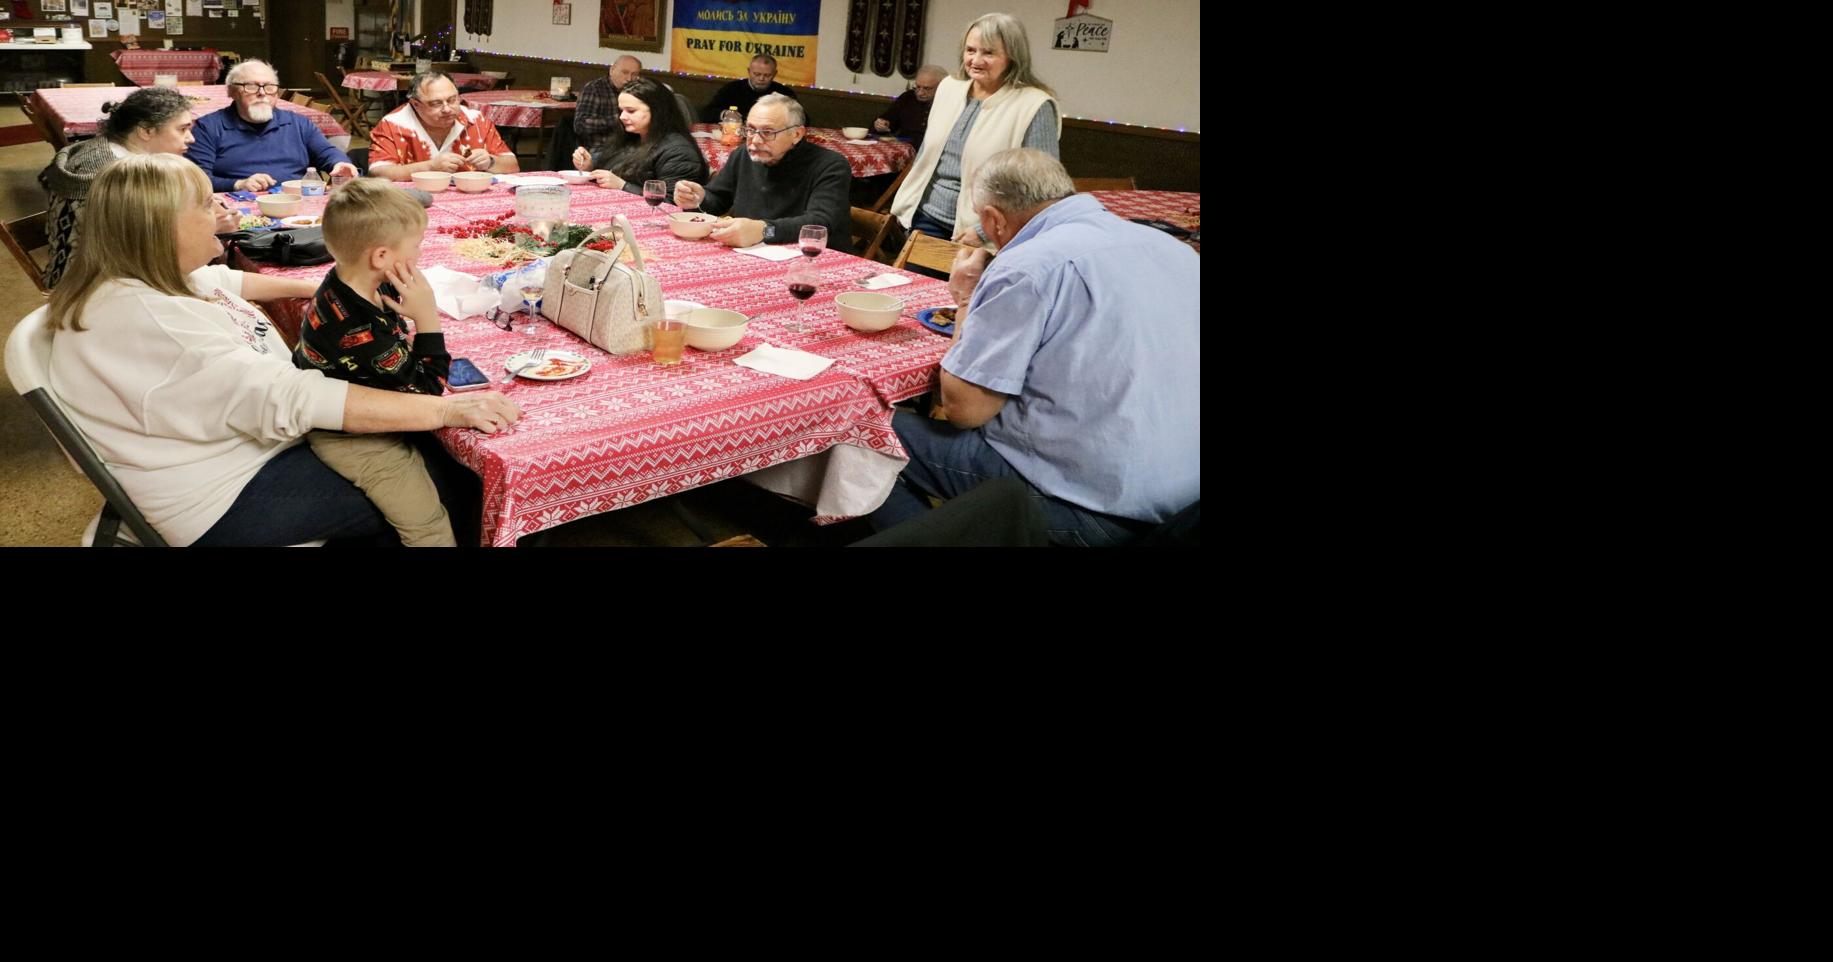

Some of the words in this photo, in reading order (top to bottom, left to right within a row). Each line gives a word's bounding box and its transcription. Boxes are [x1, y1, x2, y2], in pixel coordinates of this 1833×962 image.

[752, 10, 797, 24] УКРАЇНУ
[1076, 23, 1109, 37] Peace
[686, 38, 716, 50] PRAY
[719, 40, 742, 52] FOR
[745, 42, 805, 58] UKRAINE
